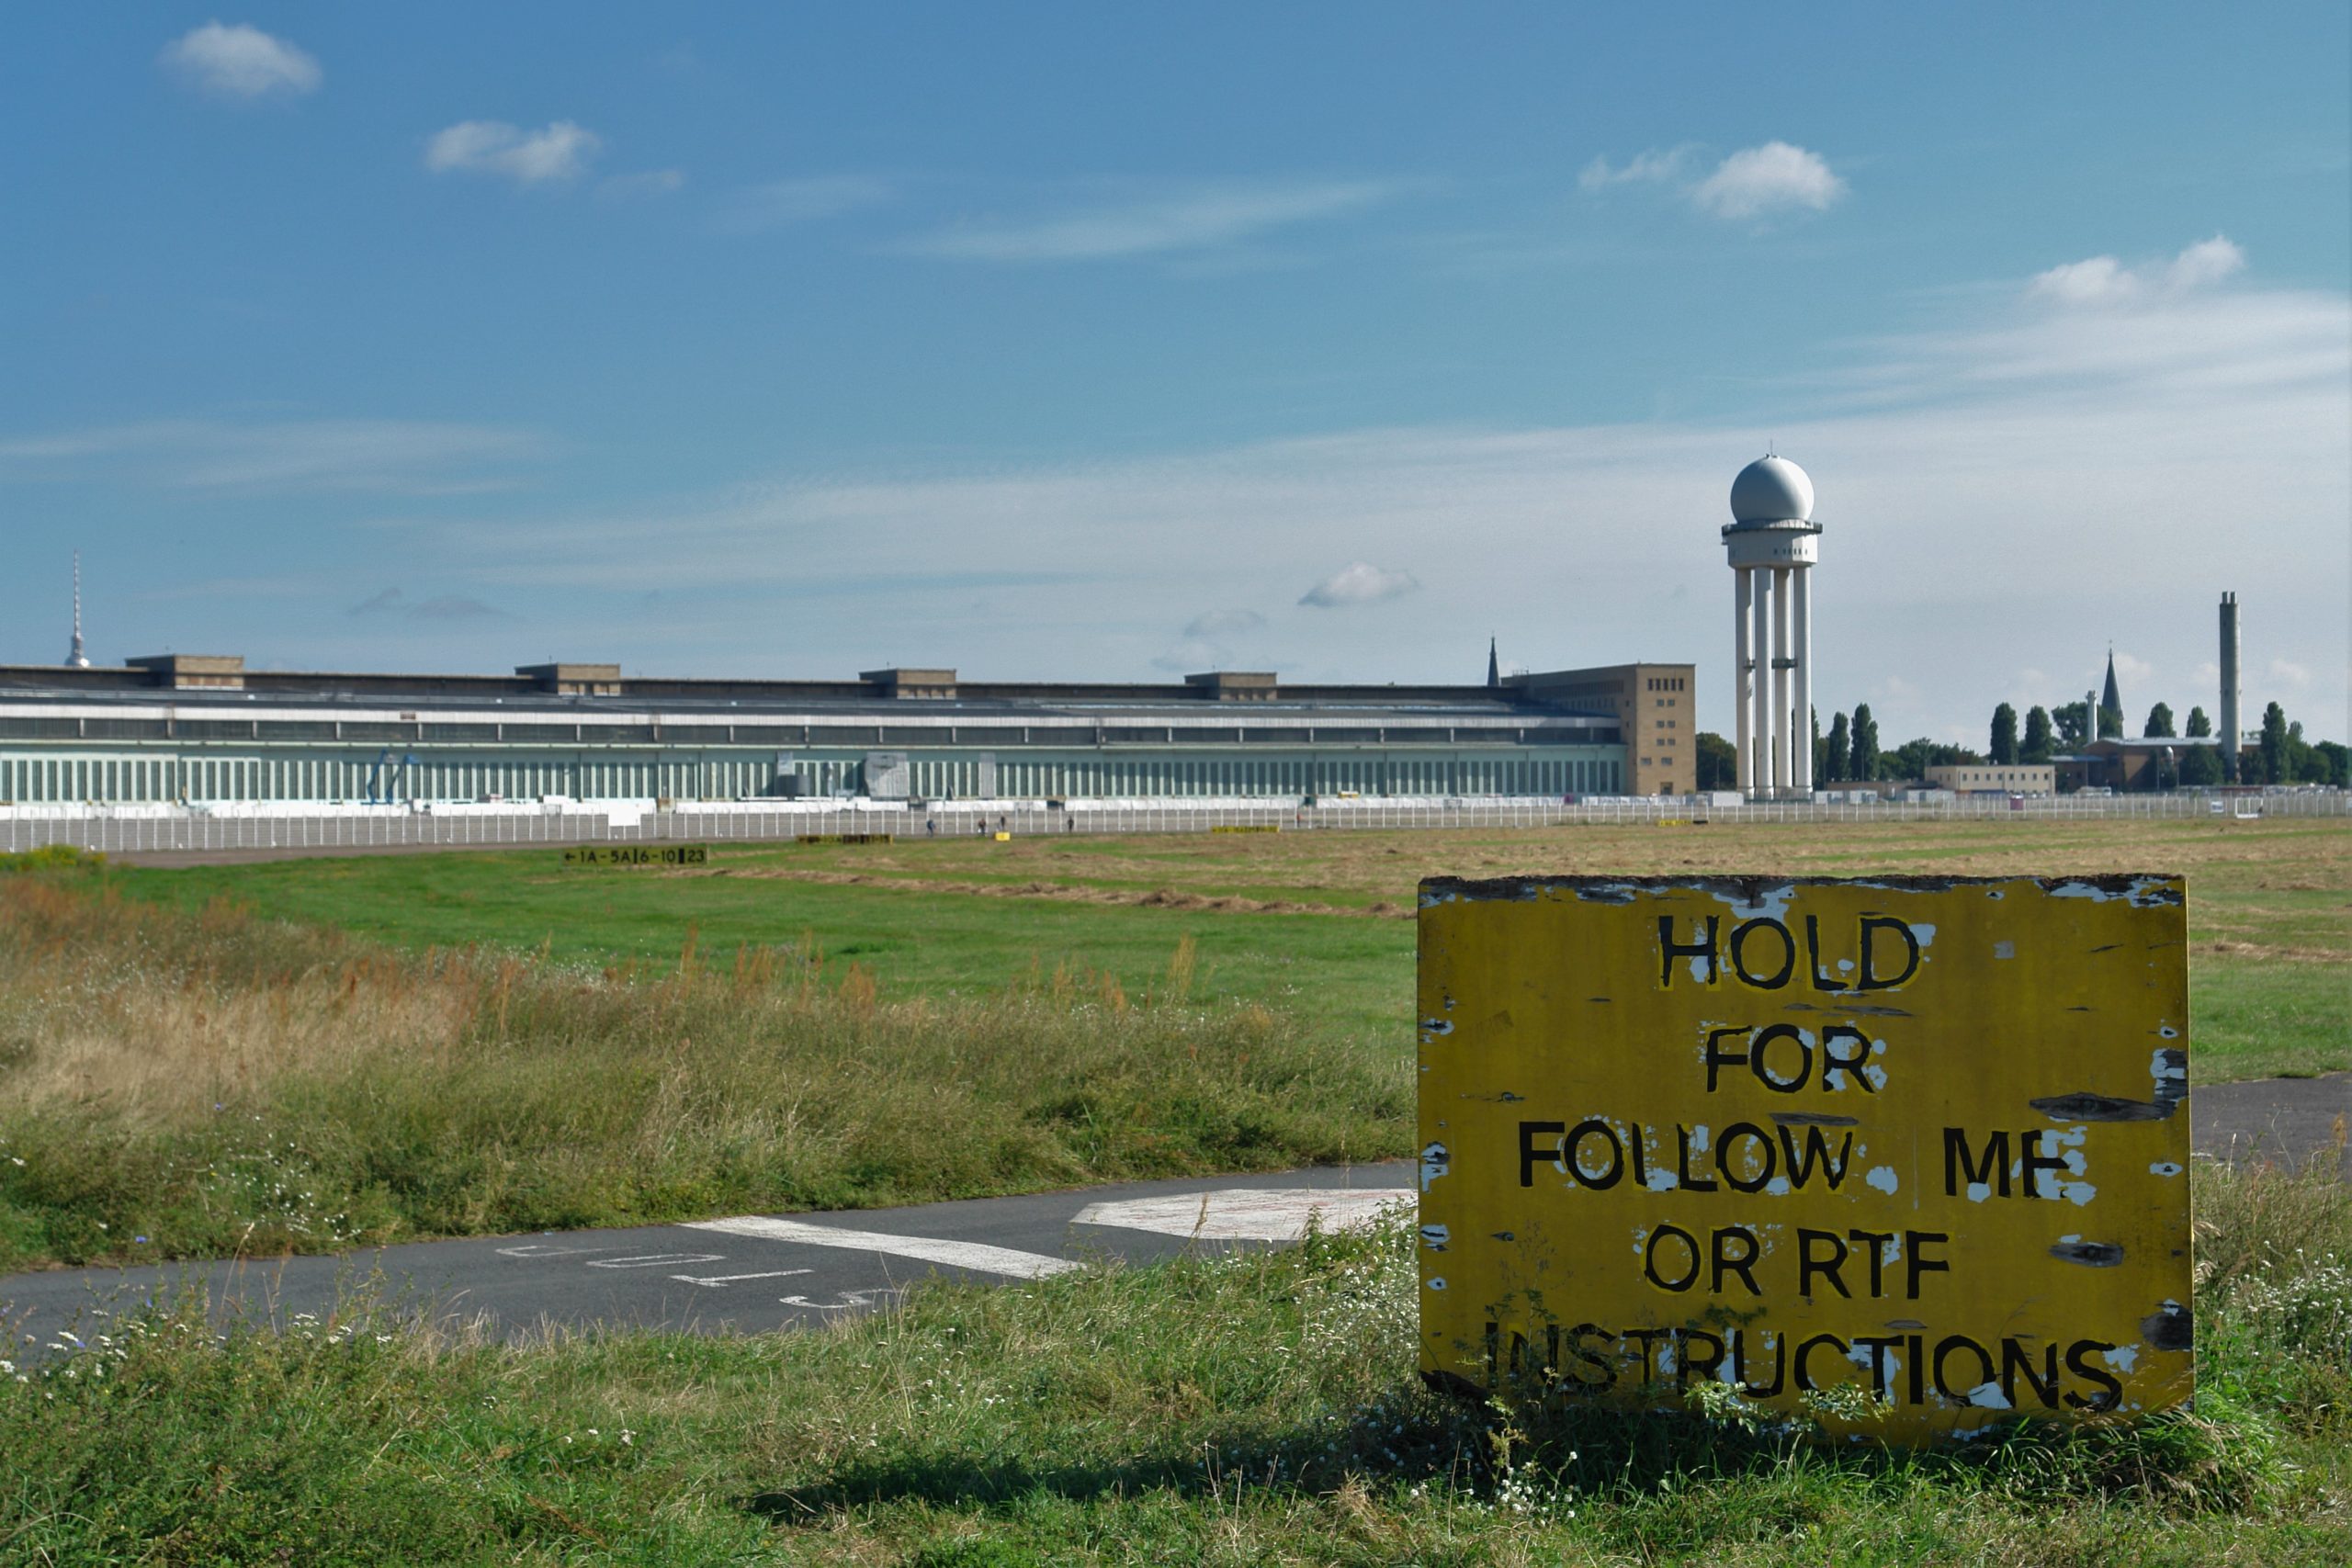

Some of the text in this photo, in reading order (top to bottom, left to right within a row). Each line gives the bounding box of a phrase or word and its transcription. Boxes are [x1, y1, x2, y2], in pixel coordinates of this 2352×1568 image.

[688, 849, 706, 863] 23
[1657, 915, 1920, 991] HOLD
[1706, 1025, 1875, 1094] FOR
[1518, 1121, 2073, 1199] FOLLOW ME
[494, 1244, 904, 1309] STOP
[1645, 1224, 1951, 1300] OR RTF
[1484, 1322, 2124, 1414] INSTRUCTIONS
